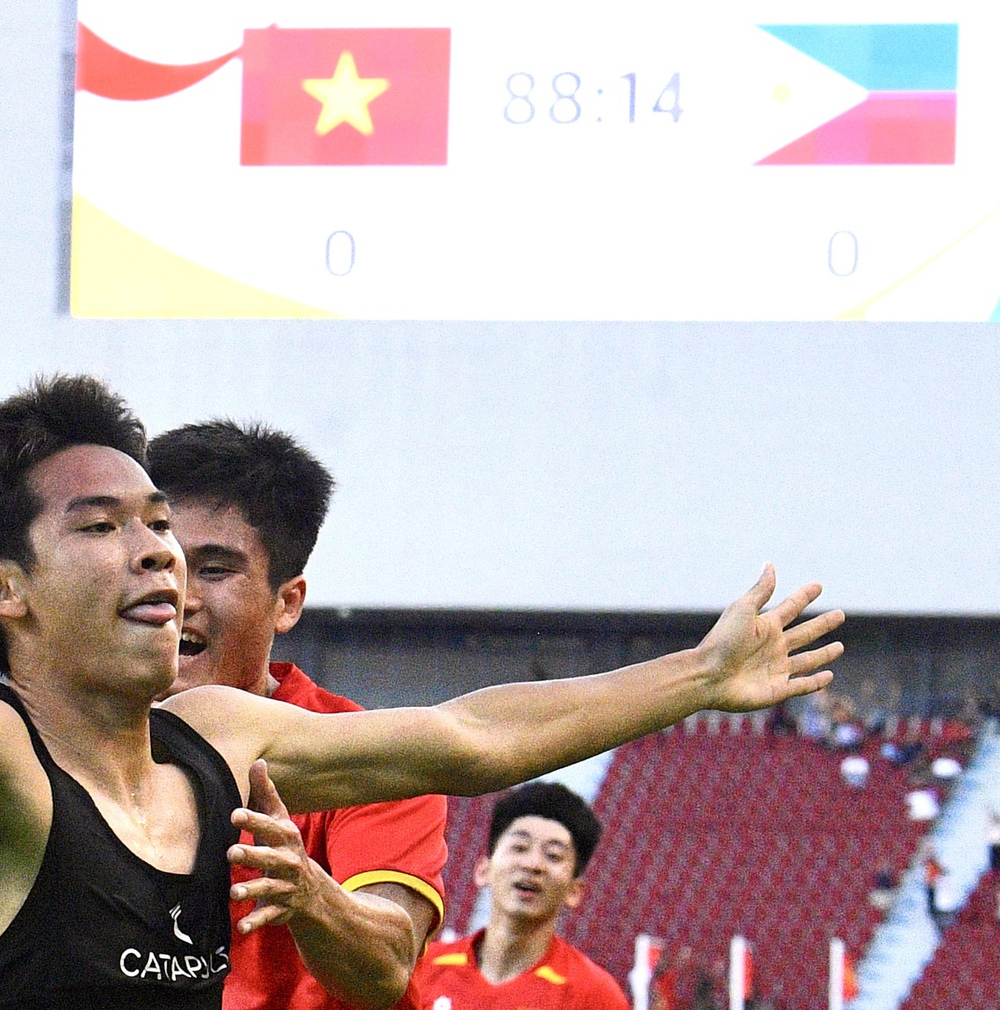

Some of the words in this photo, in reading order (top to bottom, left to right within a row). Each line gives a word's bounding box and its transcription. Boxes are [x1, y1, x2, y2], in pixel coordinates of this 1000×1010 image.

[503, 71, 684, 125] 88:14
[325, 229, 356, 277] 0
[828, 229, 859, 277] 0
